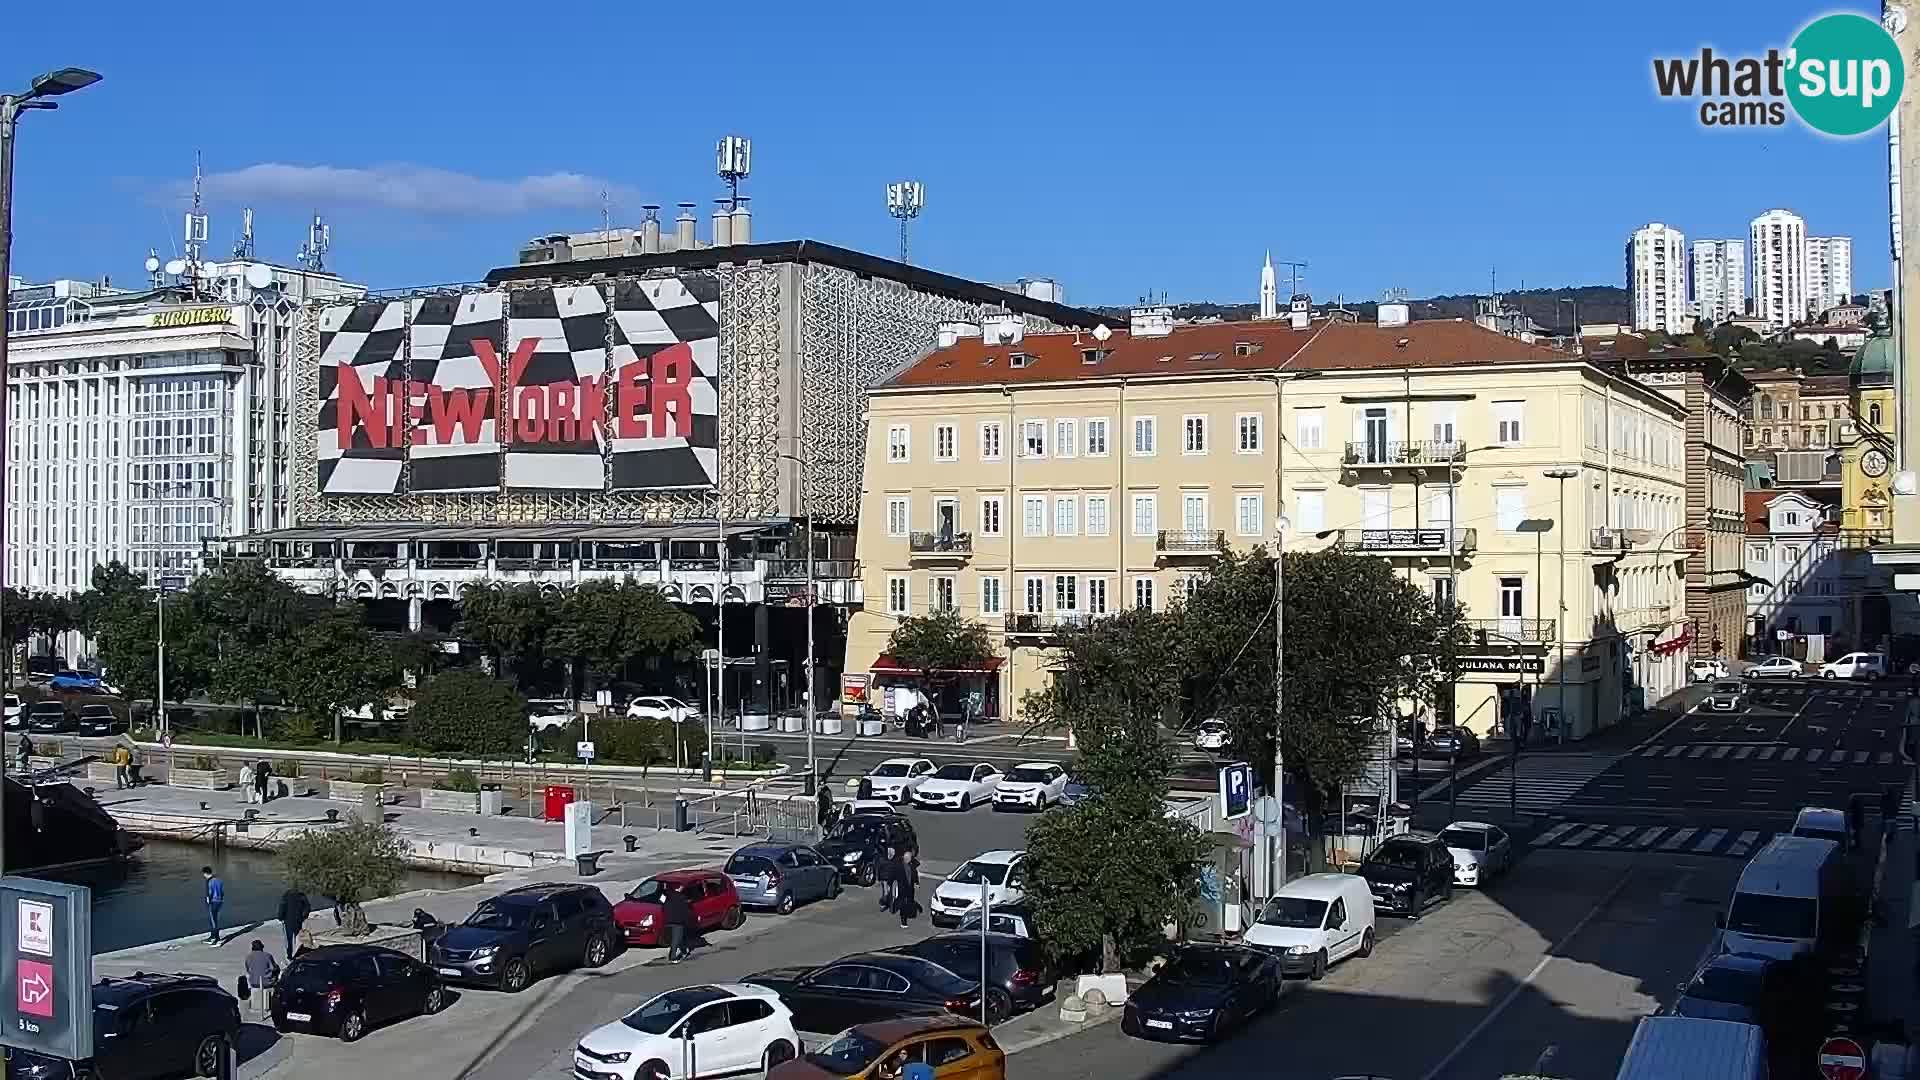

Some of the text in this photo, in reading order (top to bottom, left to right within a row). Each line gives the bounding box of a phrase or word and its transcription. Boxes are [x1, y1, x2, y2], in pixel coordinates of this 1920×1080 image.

[337, 337, 692, 450] NEW YORKER
[1458, 661, 1538, 670] JULIANA NAILS
[19, 1018, 40, 1033] 5 km
